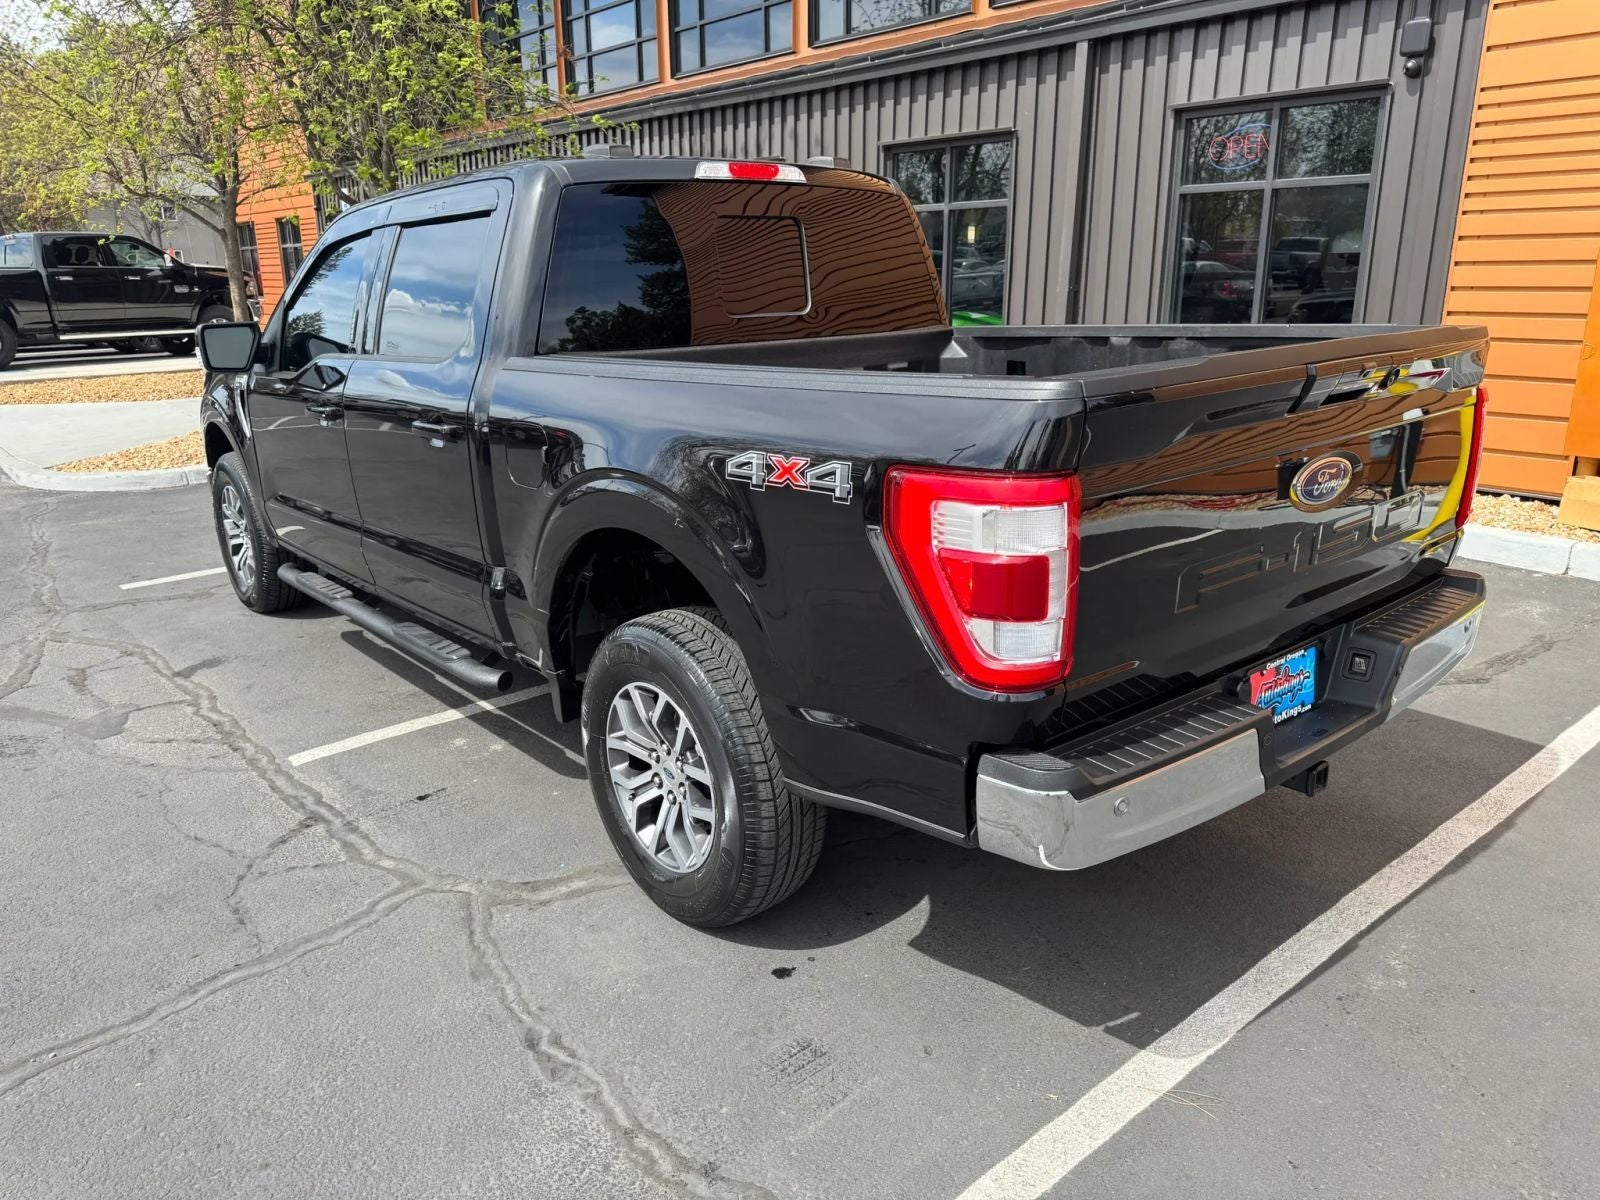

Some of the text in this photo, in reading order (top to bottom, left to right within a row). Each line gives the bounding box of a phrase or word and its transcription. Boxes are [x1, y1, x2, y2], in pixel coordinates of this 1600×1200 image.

[1209, 133, 1270, 160] OPEN
[1266, 649, 1305, 670] Central Oregon
[1272, 703, 1312, 725] toKings.com
